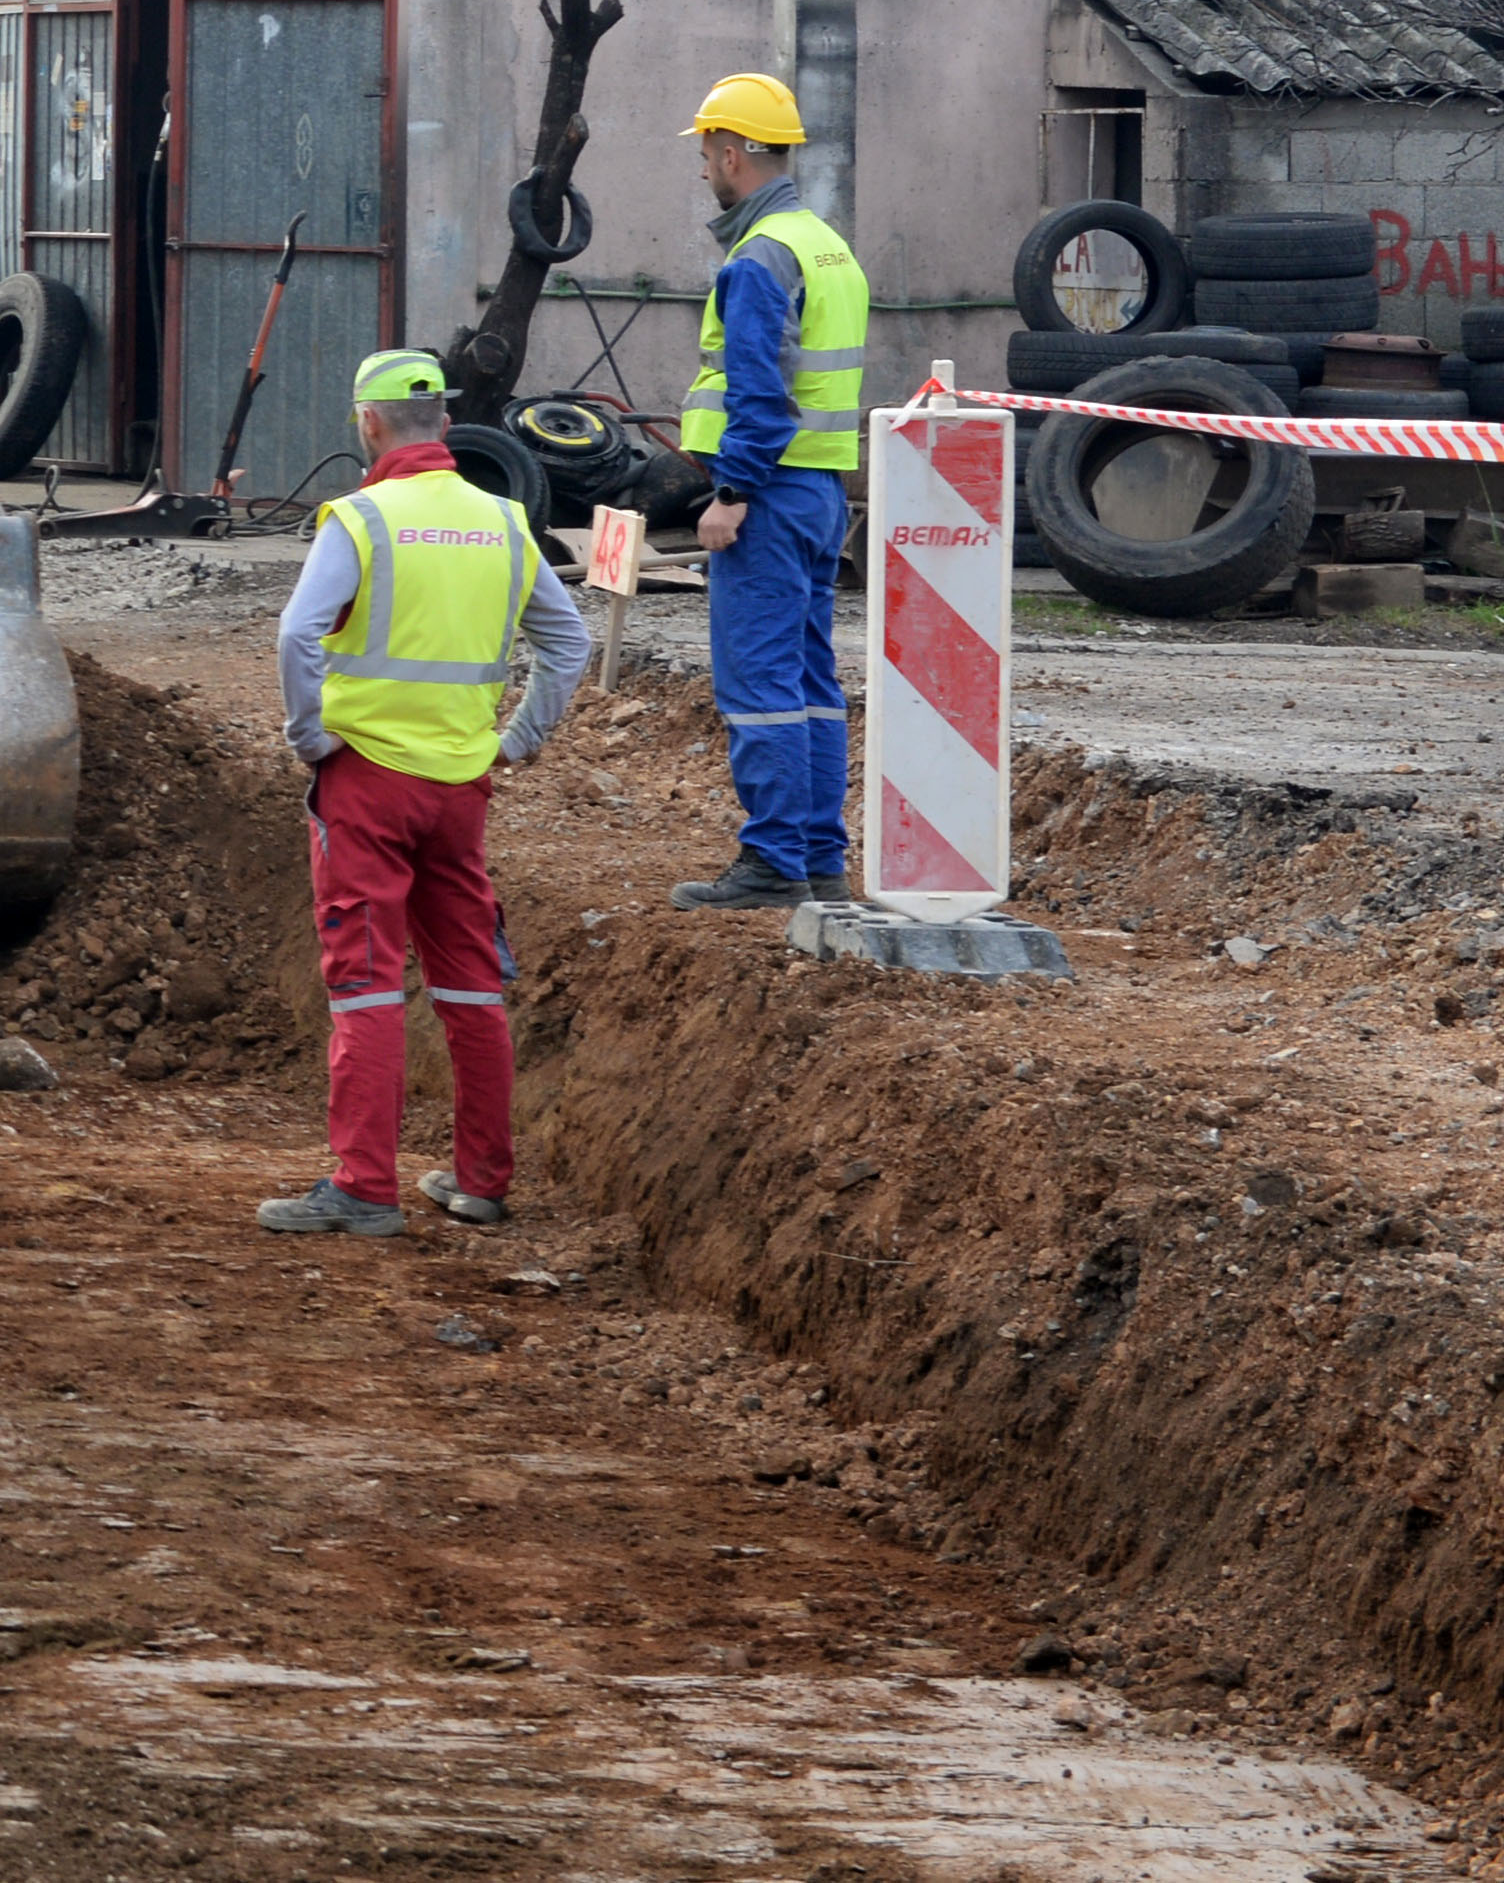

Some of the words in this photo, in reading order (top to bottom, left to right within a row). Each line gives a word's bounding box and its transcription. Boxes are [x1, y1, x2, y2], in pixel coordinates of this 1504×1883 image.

[397, 528, 505, 547] BEMAX
[892, 525, 991, 547] BEMAX
[596, 509, 626, 586] 48
